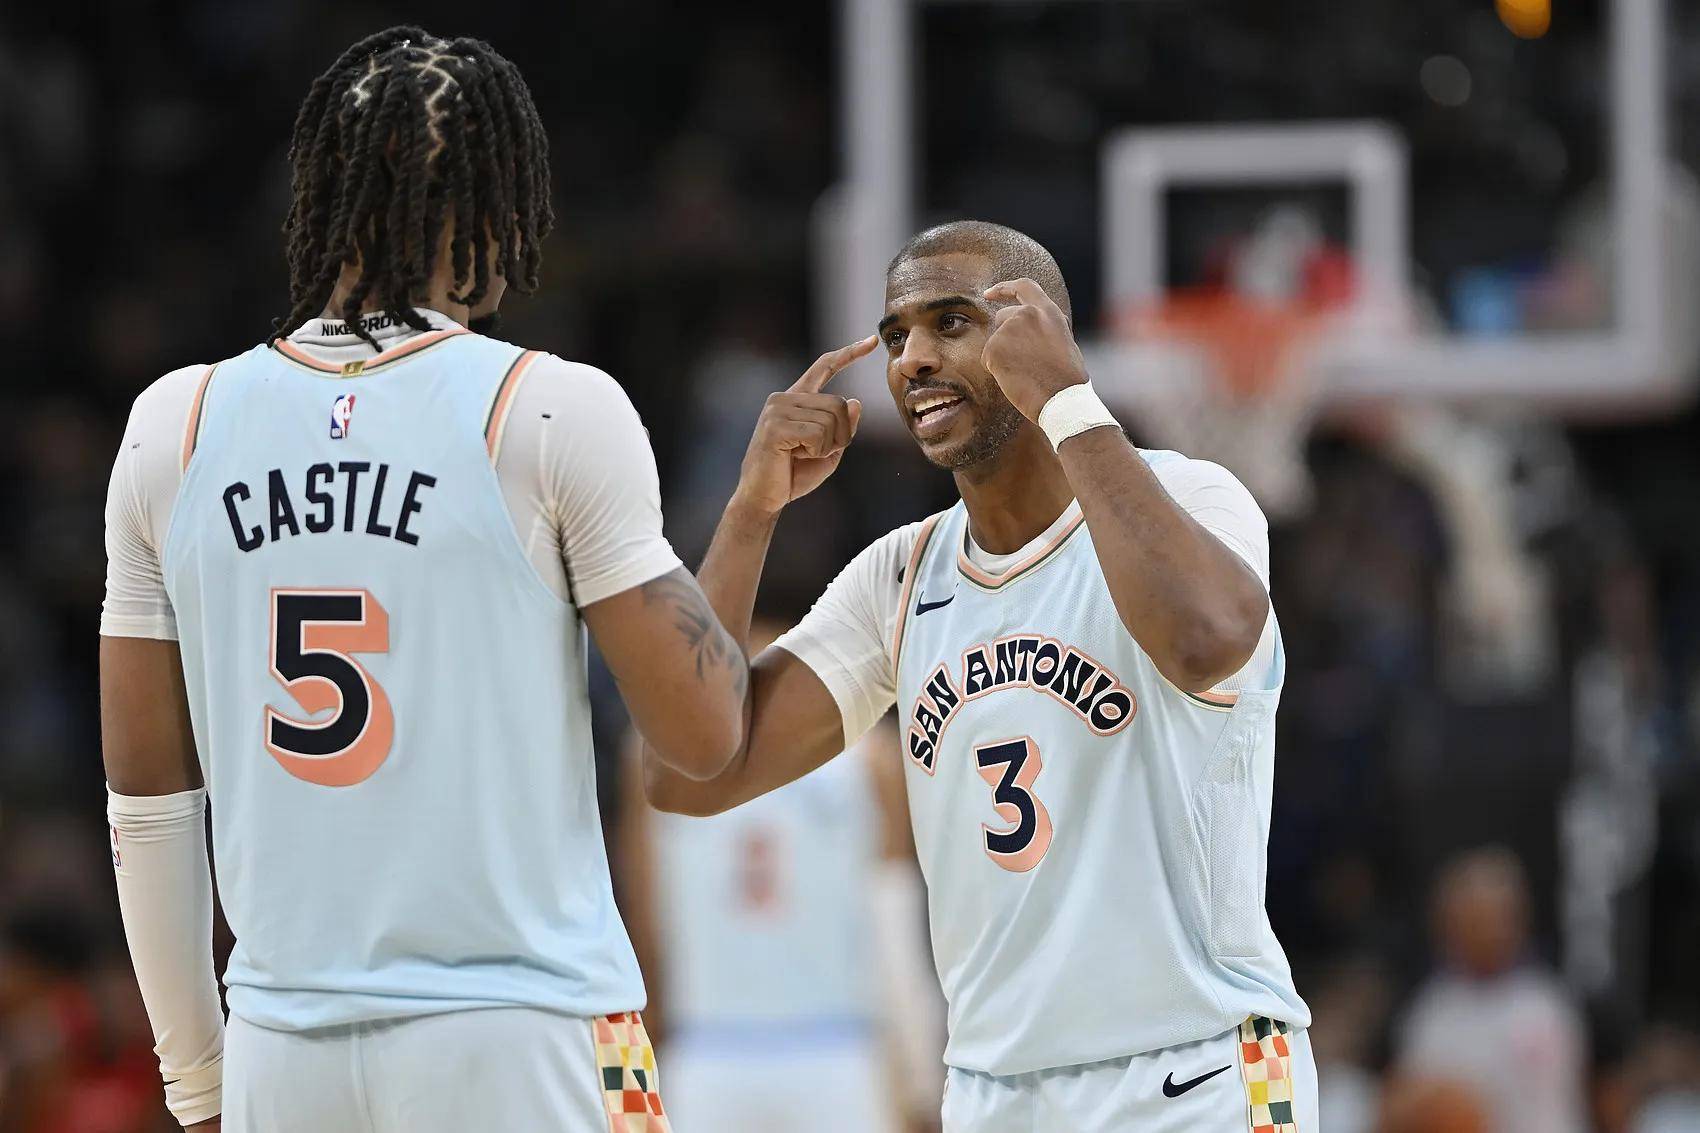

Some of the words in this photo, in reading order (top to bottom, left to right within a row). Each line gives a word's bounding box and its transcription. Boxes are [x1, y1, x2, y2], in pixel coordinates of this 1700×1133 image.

[222, 461, 437, 552] CASTLE
[264, 587, 395, 787] 5
[909, 664, 963, 775] SAN
[963, 634, 1136, 736] ANTONIO
[974, 736, 1053, 872] 3
